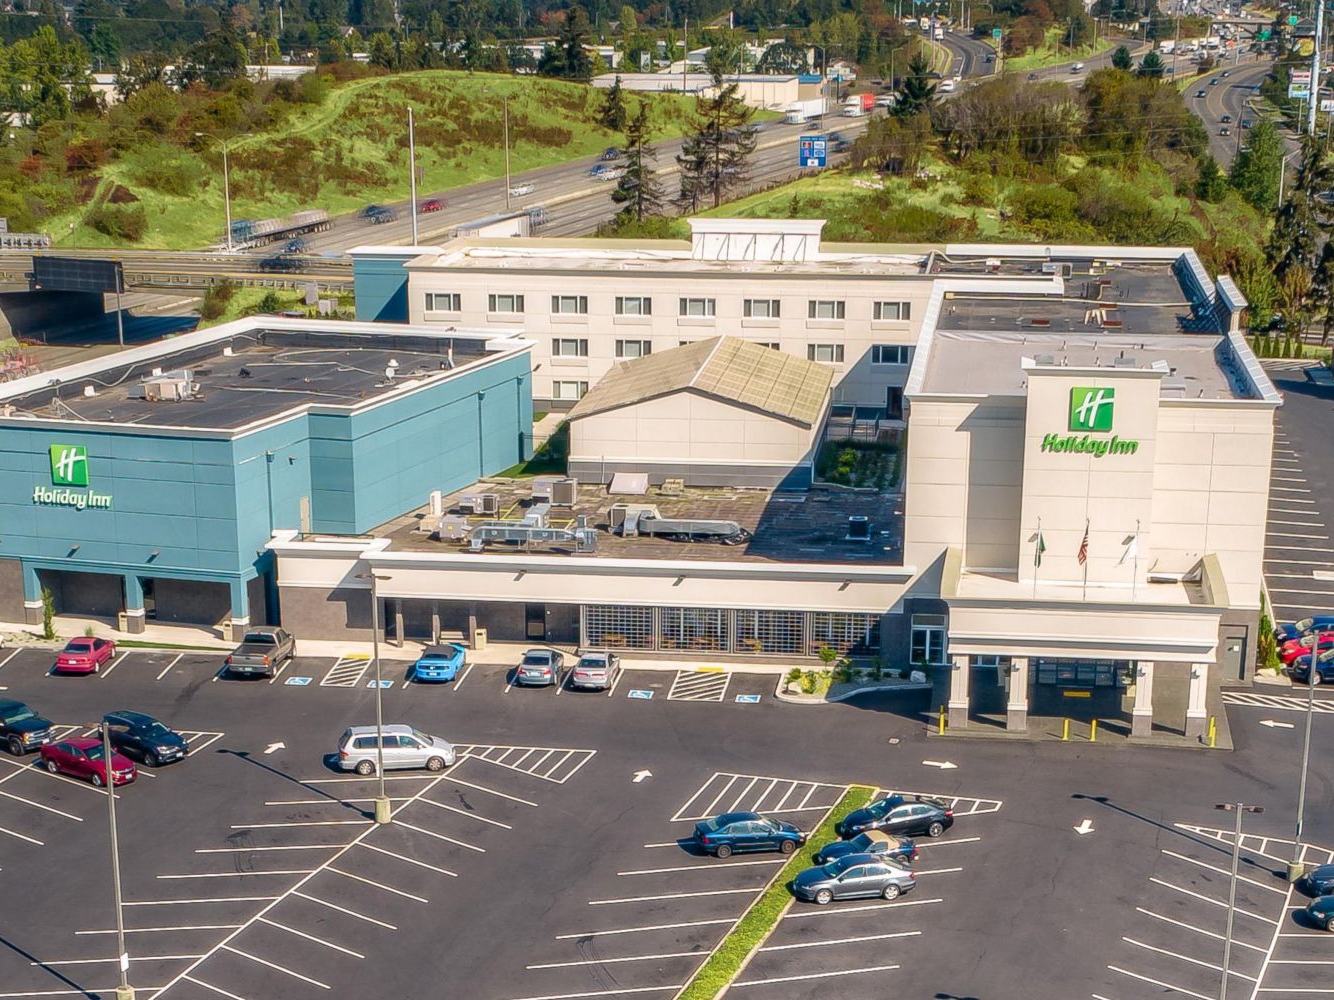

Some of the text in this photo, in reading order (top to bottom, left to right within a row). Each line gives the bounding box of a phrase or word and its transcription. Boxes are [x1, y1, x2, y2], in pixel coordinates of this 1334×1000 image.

[1041, 433, 1139, 458] Holiday Inn
[33, 486, 112, 509] Holiday Inn
